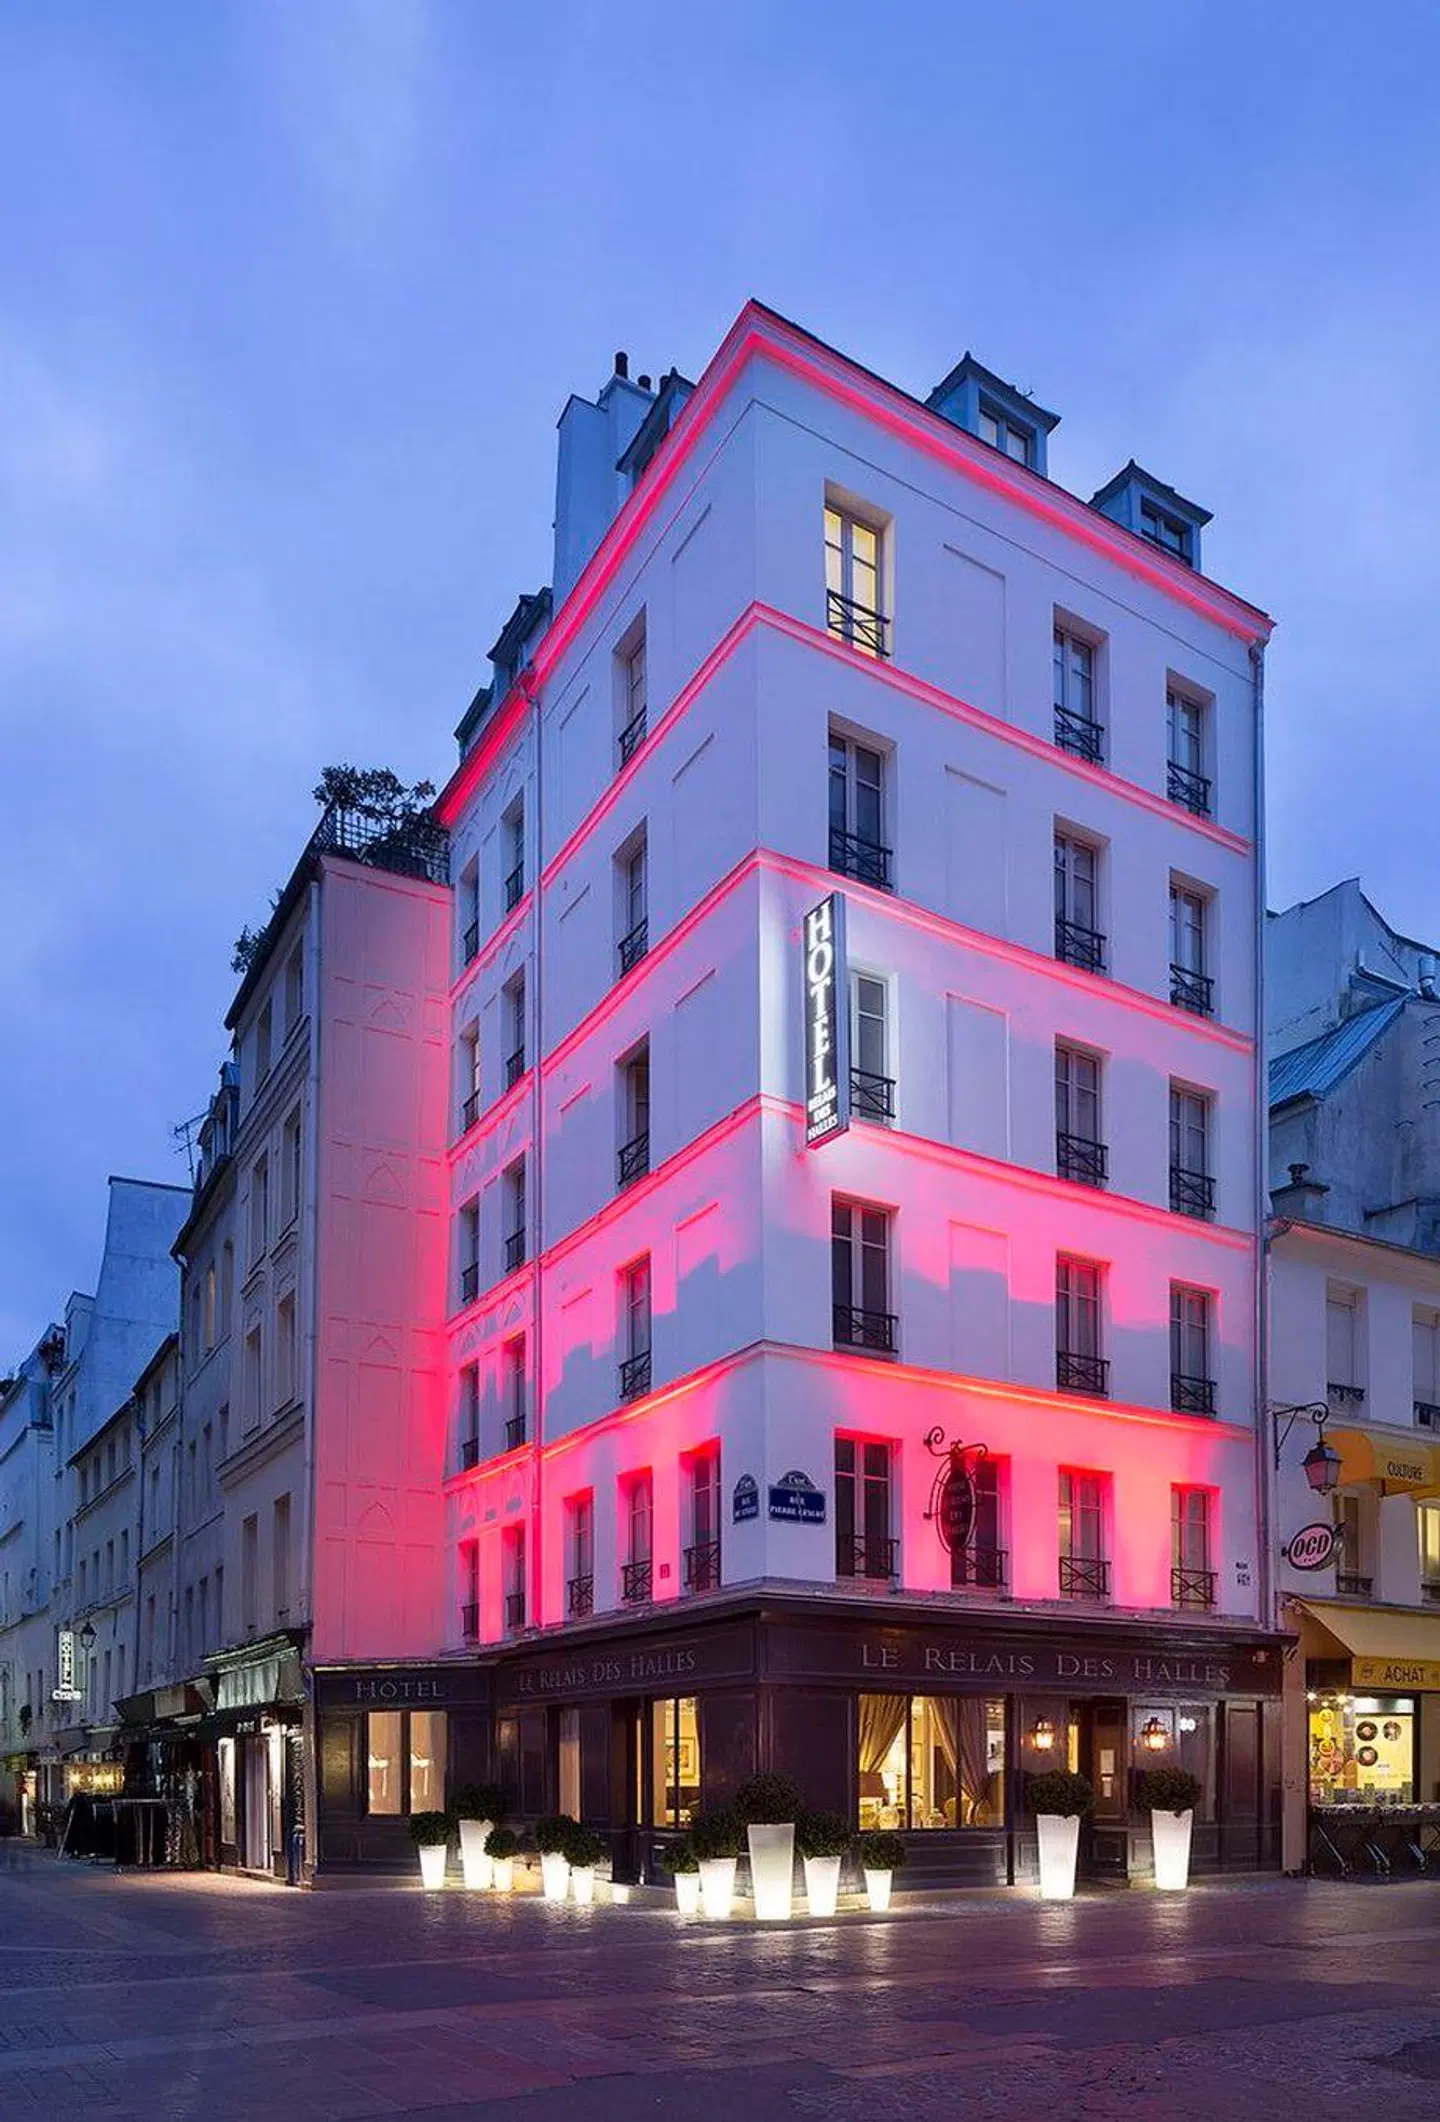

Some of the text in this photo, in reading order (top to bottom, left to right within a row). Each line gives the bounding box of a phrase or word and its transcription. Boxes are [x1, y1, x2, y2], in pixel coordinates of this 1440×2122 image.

[808, 901, 834, 1095] HOTEL
[518, 1650, 697, 1692] LE RELAIS DES HALLES
[862, 1643, 1231, 1684] LE RELAIS DES HALLES
[1383, 1665, 1425, 1683] ACHAT
[356, 1680, 445, 1699] HOTEL
